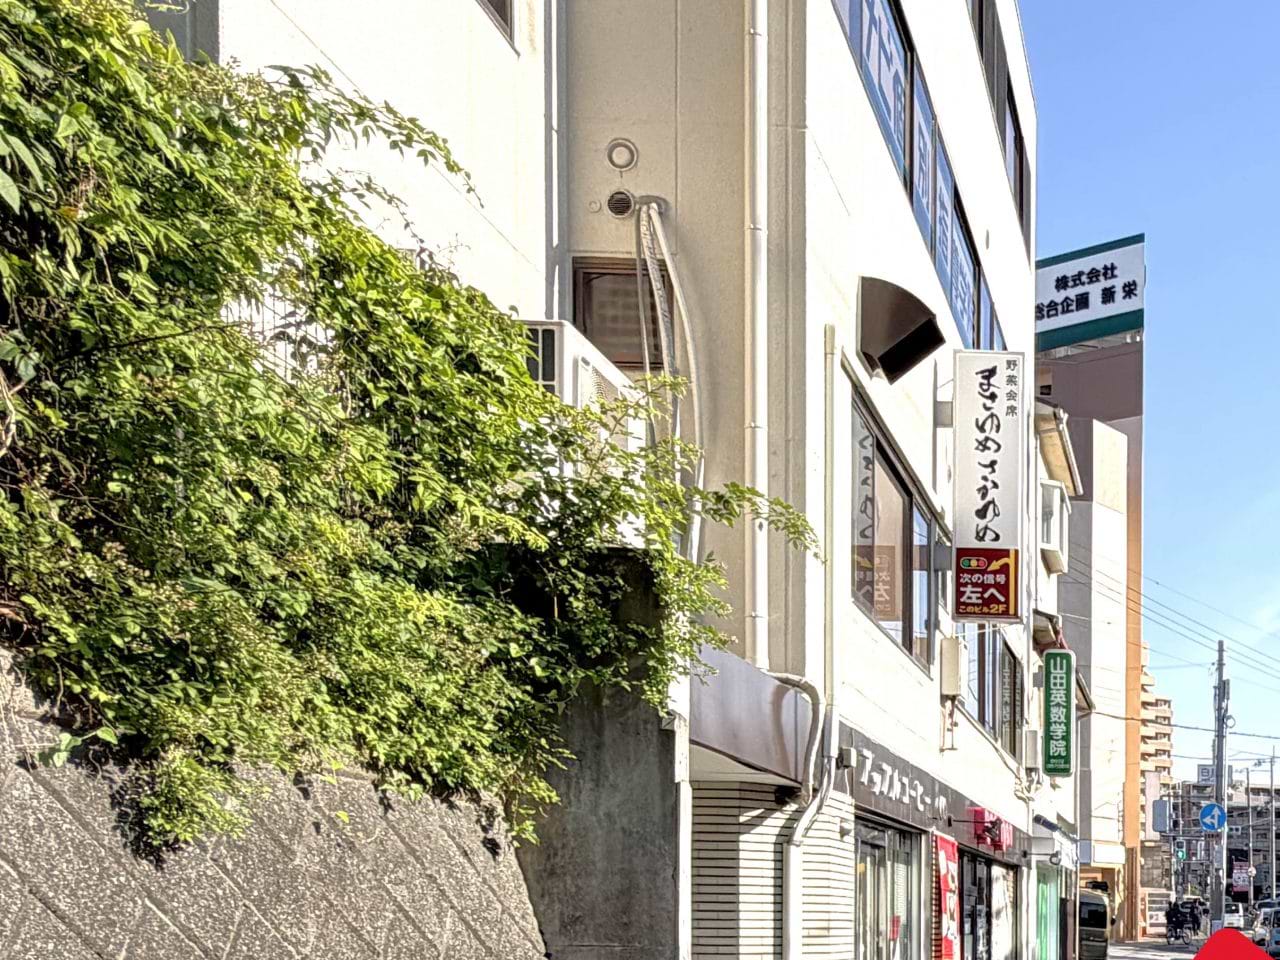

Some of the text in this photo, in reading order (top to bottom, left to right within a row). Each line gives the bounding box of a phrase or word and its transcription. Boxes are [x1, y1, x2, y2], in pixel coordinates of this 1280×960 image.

[1054, 262, 1118, 293] 株式会社
[1005, 359, 1018, 417] 野菜会席
[974, 365, 1002, 543] まさゆめさかゆめ
[960, 573, 1006, 585] 次の信号
[960, 584, 1006, 604] 左へ
[958, 603, 1008, 614] このビル2F
[1049, 656, 1067, 757] 山田英数学院
